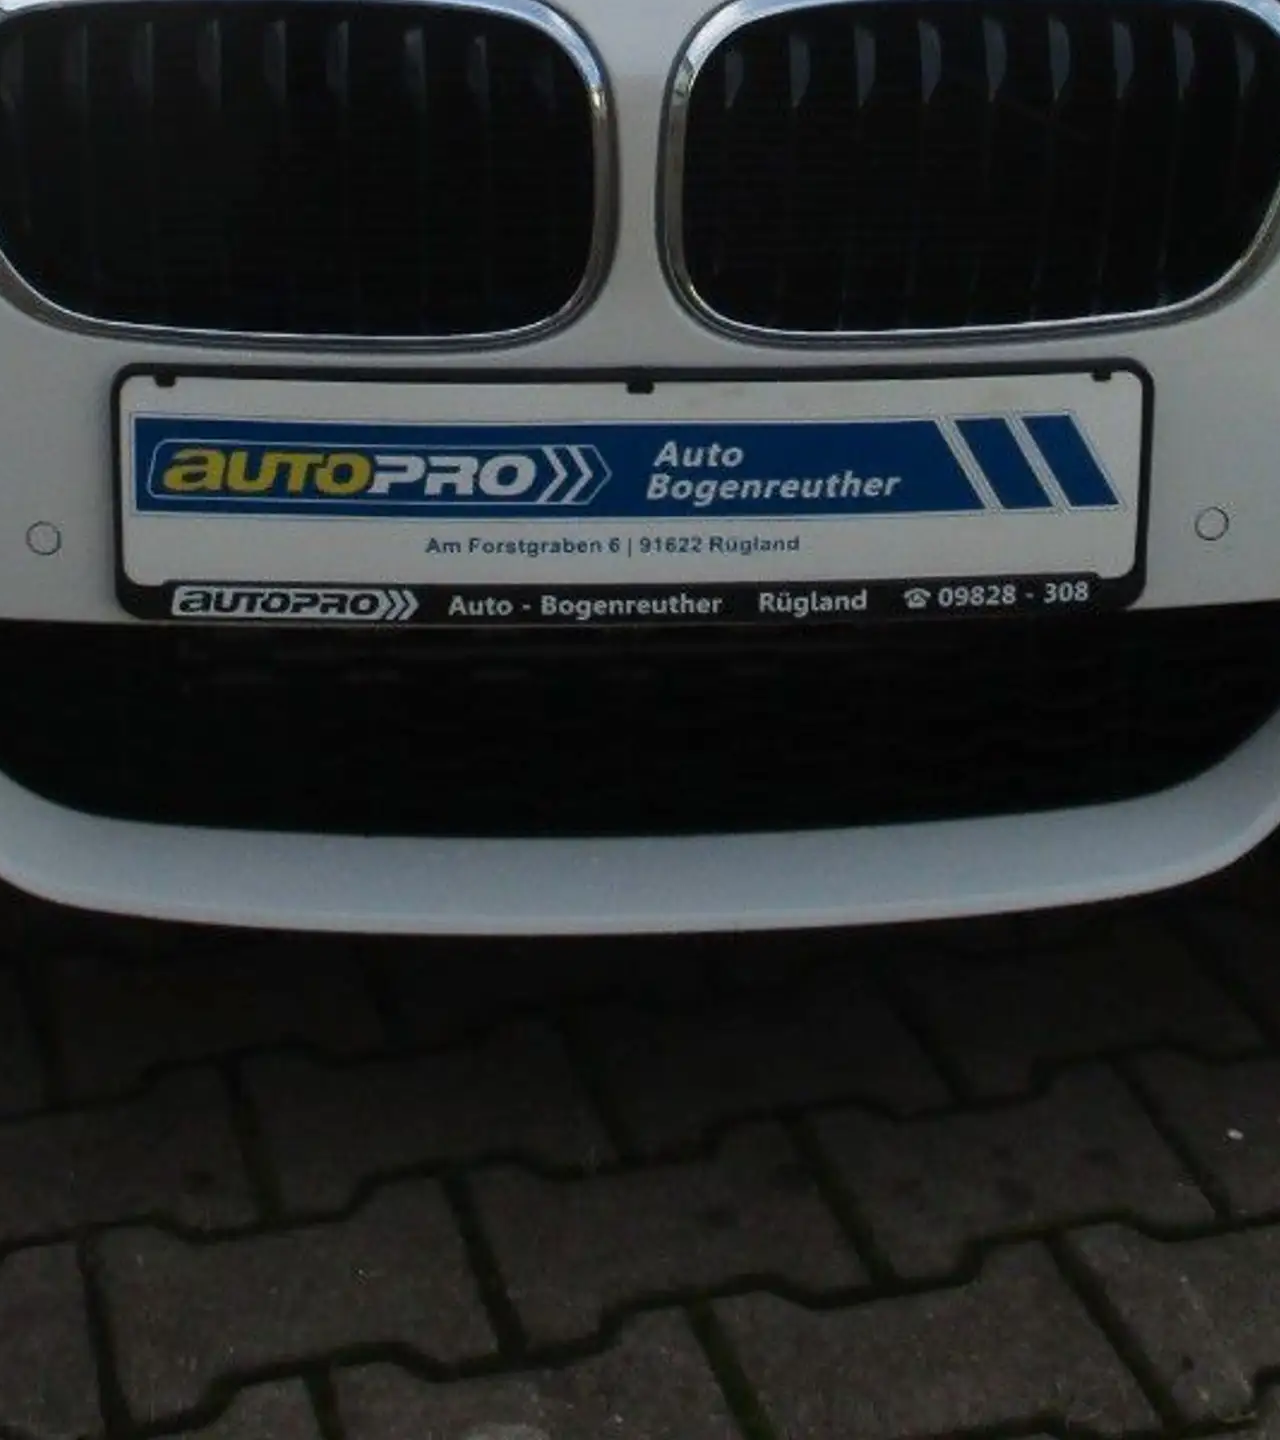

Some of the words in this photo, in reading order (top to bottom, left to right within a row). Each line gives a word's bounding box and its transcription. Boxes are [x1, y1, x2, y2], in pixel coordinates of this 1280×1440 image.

[654, 441, 744, 467] Auto
[647, 471, 901, 507] Bogenreuther
[426, 537, 462, 554] Am
[469, 537, 601, 558] Forstgraben
[609, 537, 620, 553] 6
[640, 536, 702, 554] 91622
[709, 535, 800, 556] Rügland
[448, 596, 513, 616] Auto
[541, 594, 722, 620] Bogenreuther
[758, 590, 868, 618] Rügland
[938, 585, 1016, 607] 09828
[1043, 582, 1089, 603] 308
